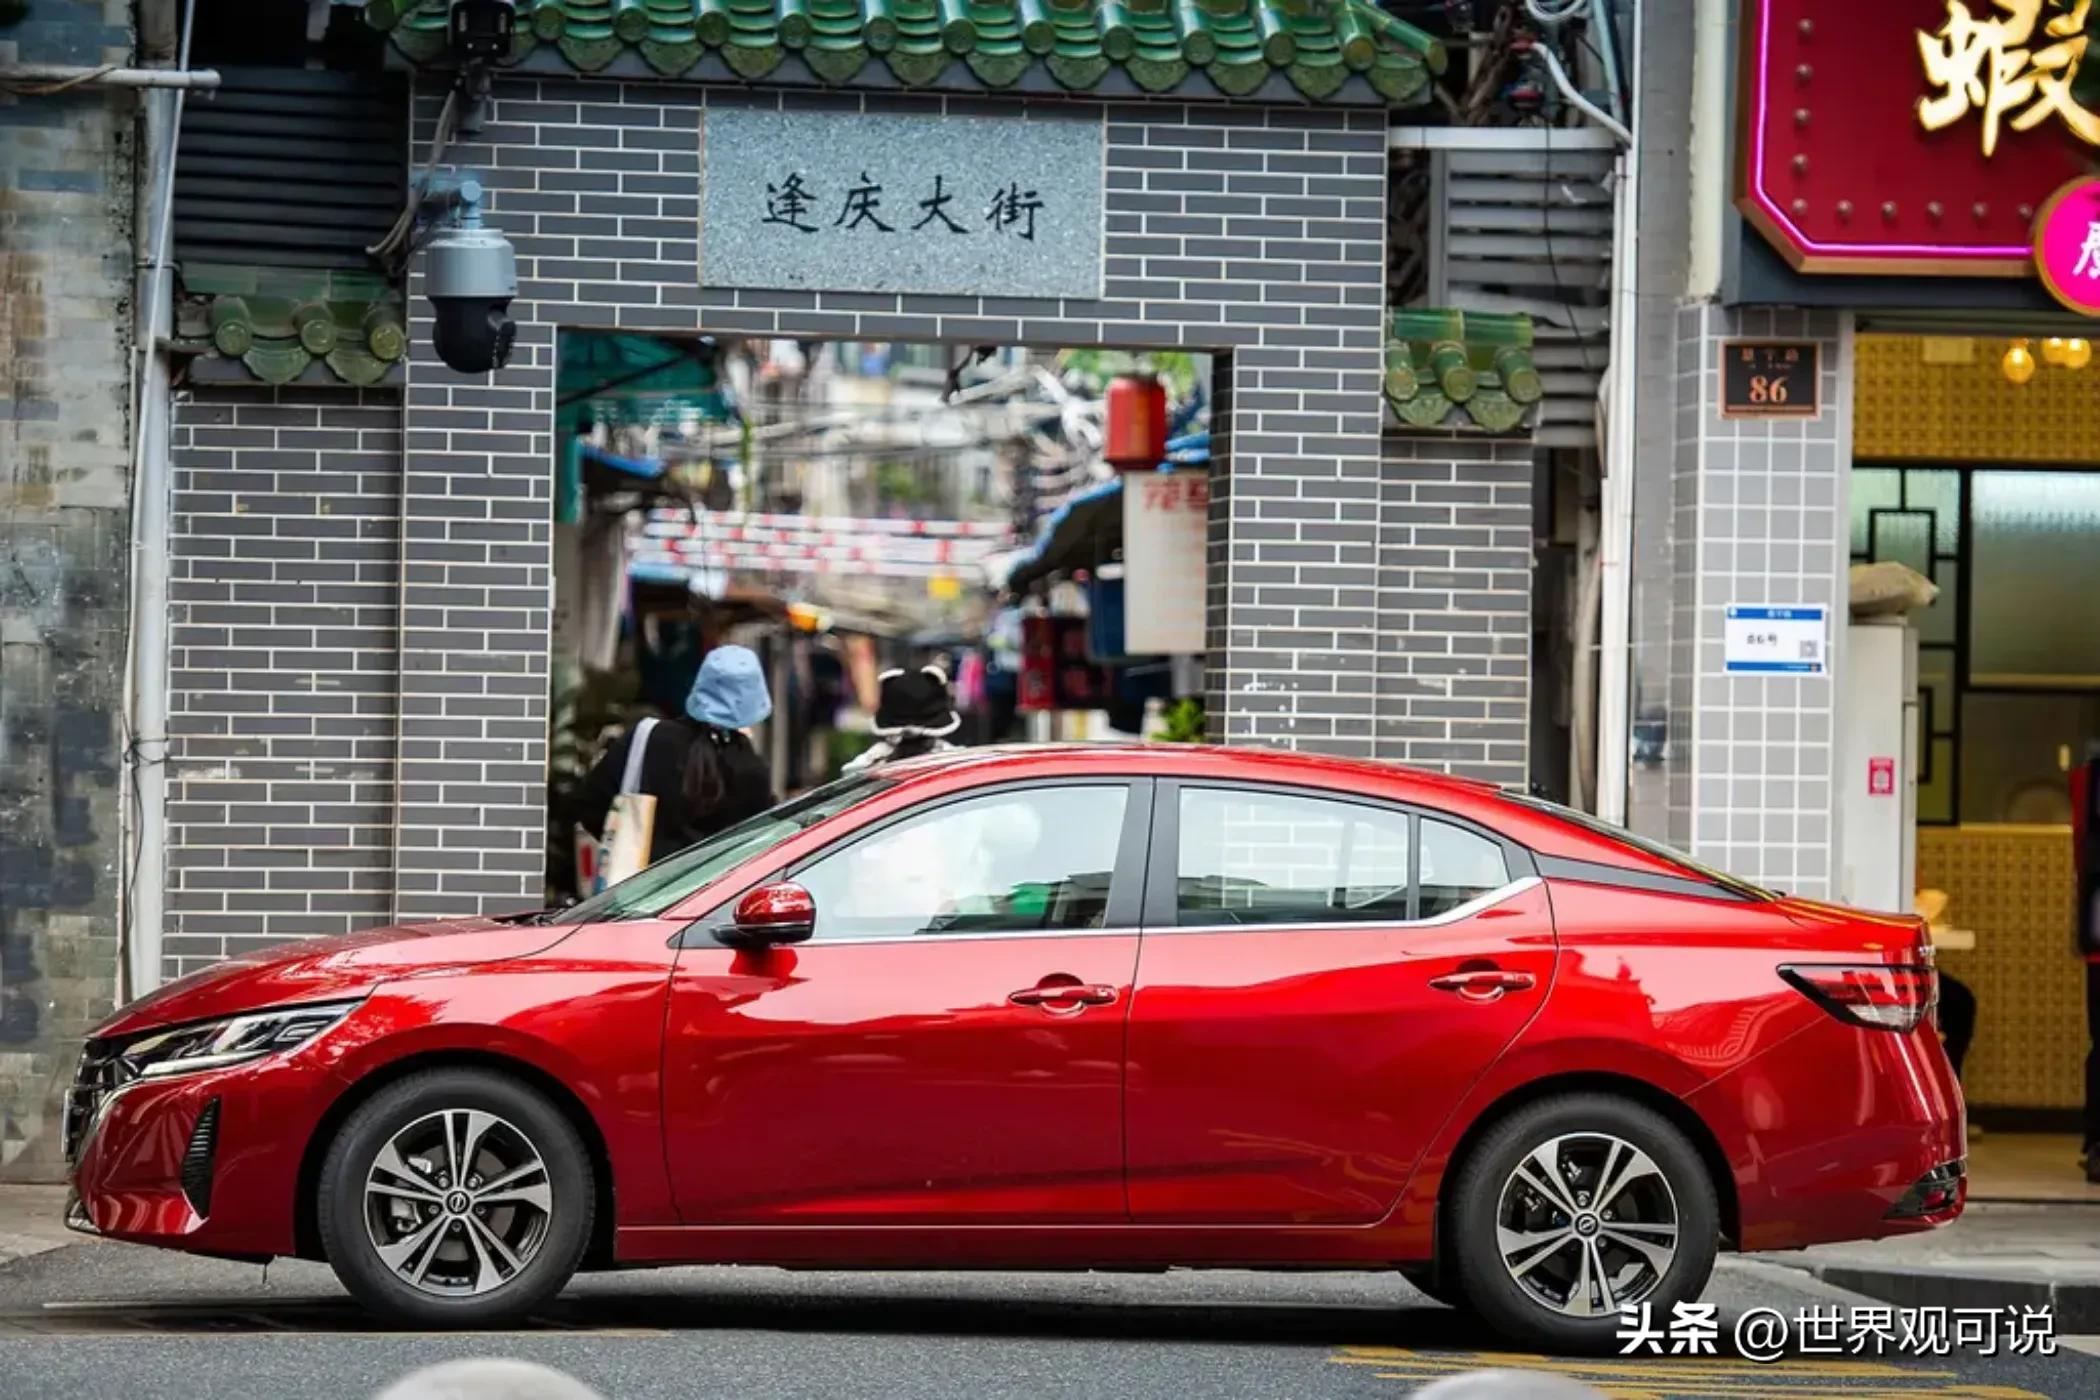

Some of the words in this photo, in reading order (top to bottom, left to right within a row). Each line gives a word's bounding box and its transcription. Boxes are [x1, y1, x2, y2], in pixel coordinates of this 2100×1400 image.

[762, 171, 1045, 241] 逢庆大街
[1749, 375, 1788, 403] 86
